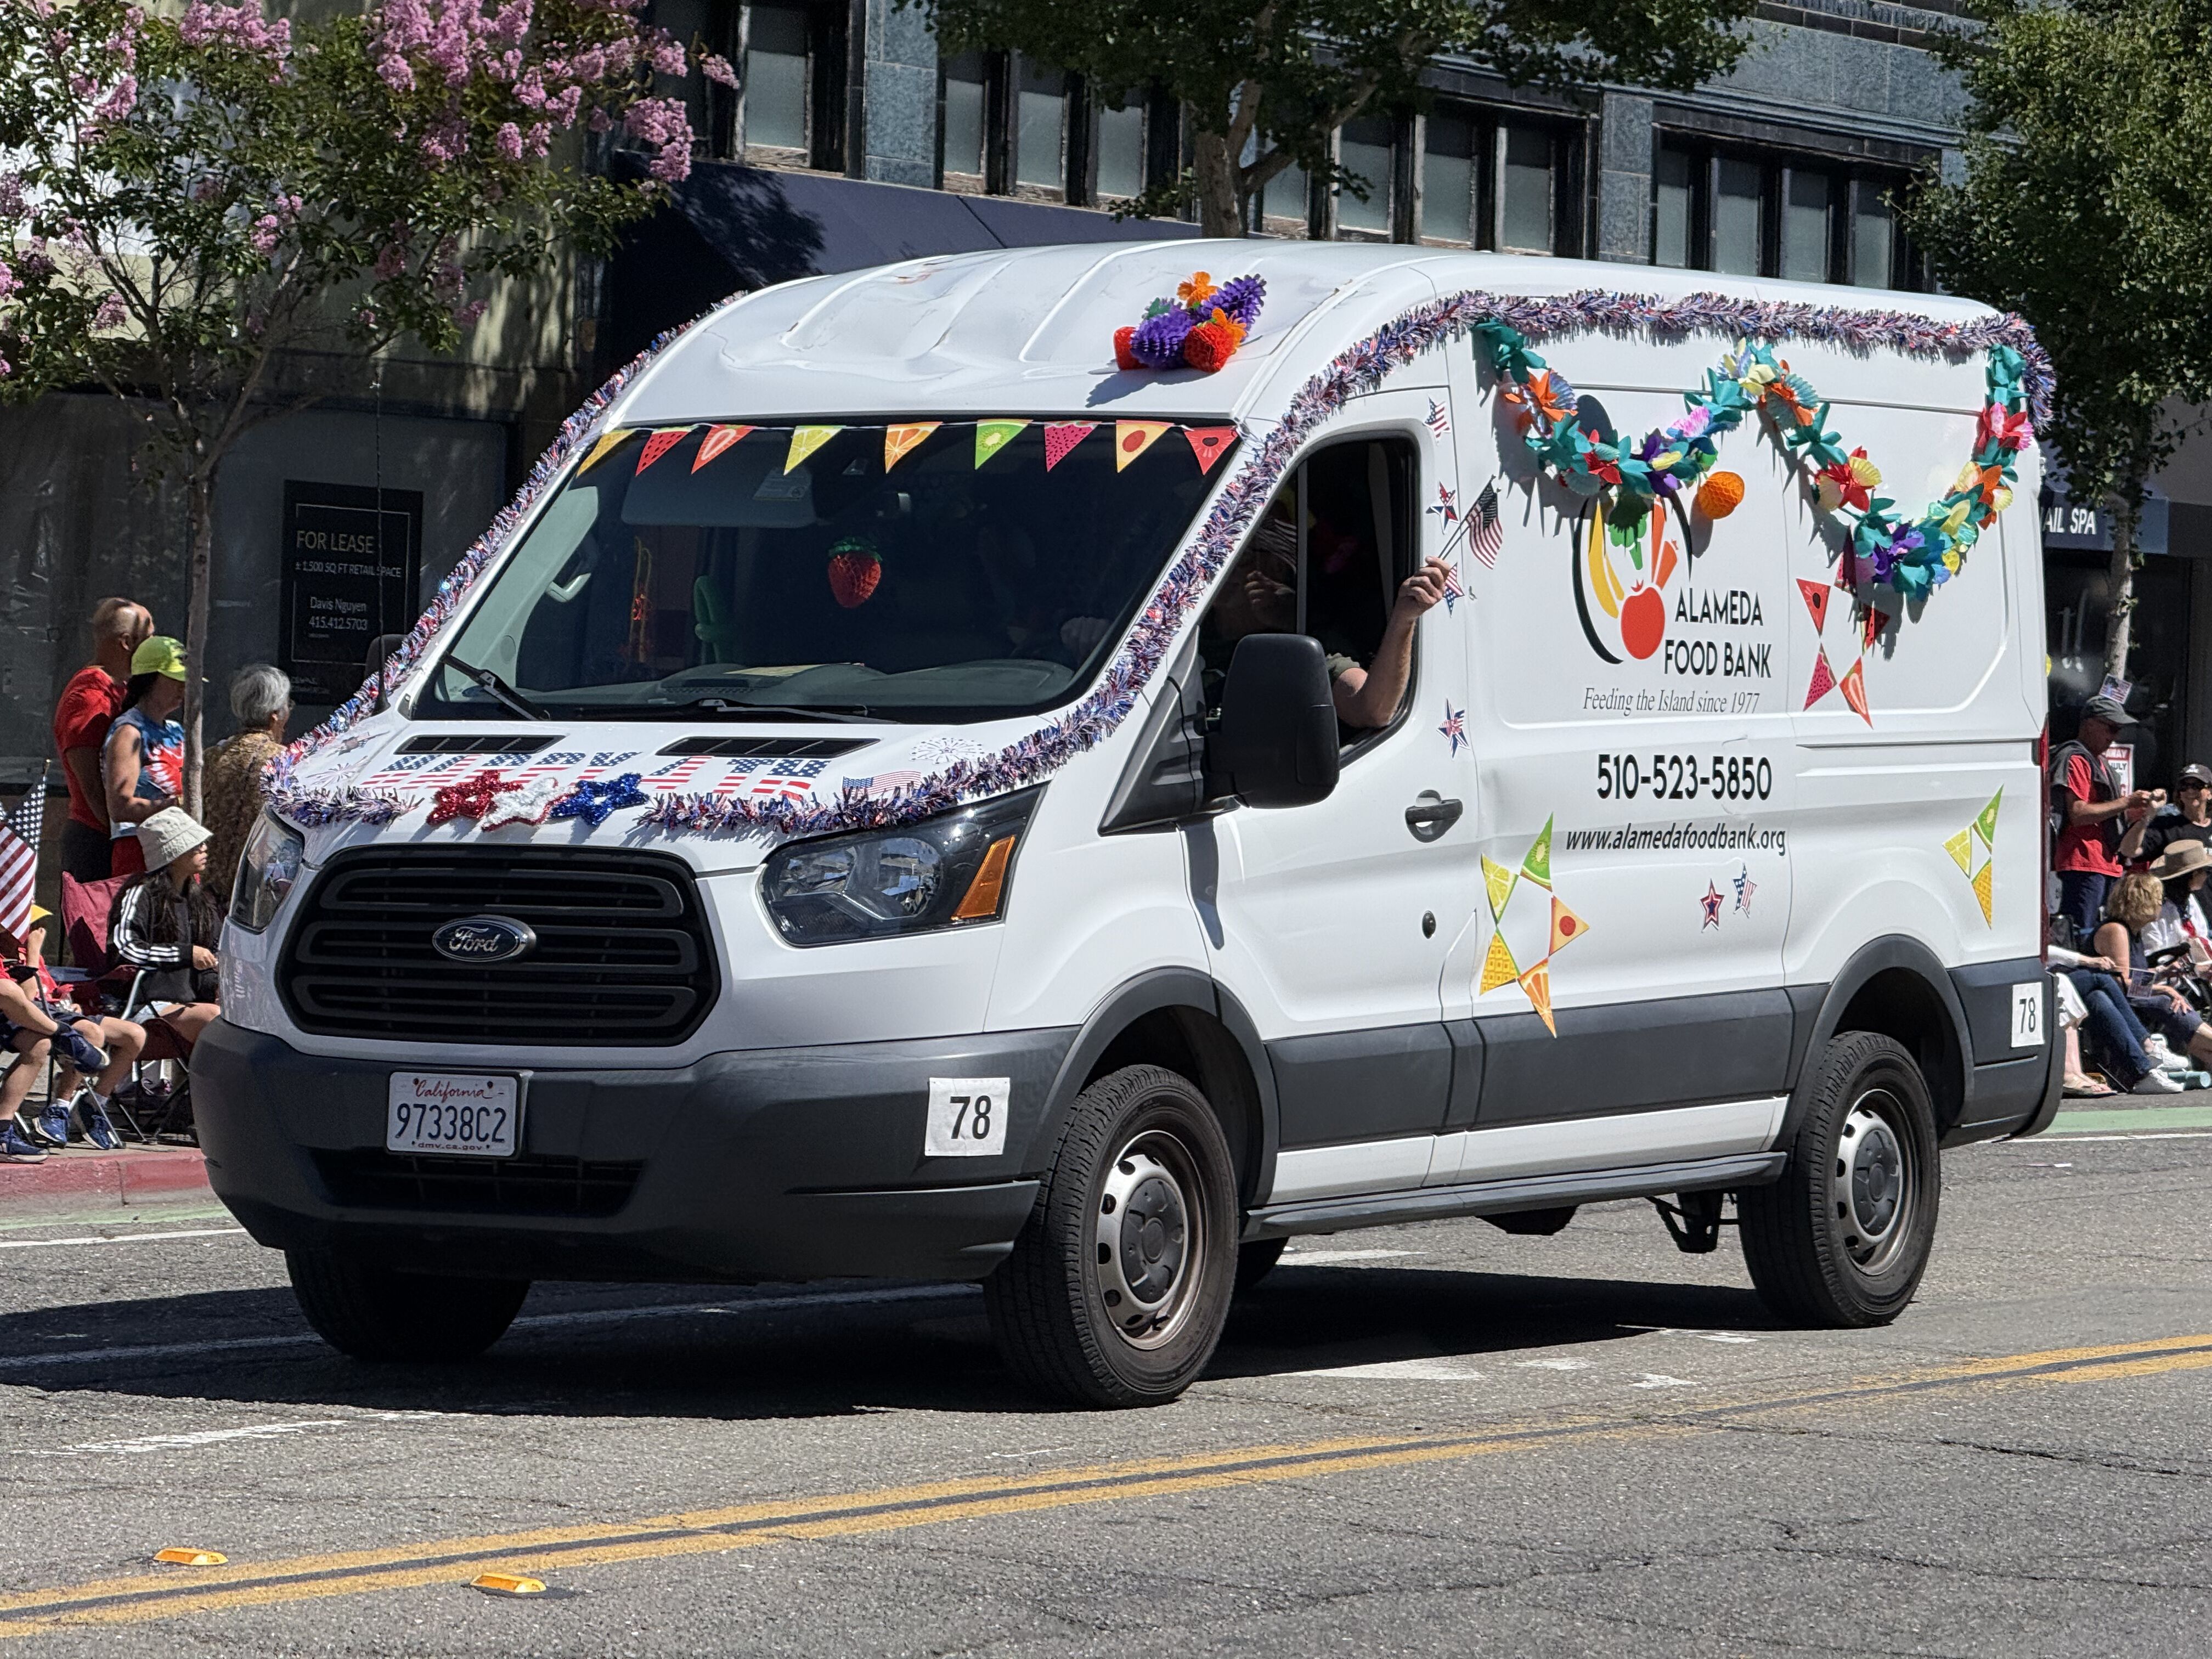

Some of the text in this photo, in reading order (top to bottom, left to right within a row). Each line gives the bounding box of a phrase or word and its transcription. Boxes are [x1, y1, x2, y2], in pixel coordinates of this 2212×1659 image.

[2040, 507, 2096, 534] AIL SPA
[296, 530, 374, 554] FOR LEASE
[349, 564, 375, 575] RETAIL
[310, 597, 366, 614] Davis Nguyen
[1675, 587, 1764, 626] ALAMEDA
[1664, 639, 1772, 678] FOOD BANK
[1583, 687, 1760, 716] Feeding the Island since 1977
[1597, 754, 1772, 800] 510-523-5850
[1566, 822, 1786, 856] www.alamedafoodbank.org
[449, 926, 500, 952] Ford
[2019, 997, 2035, 1034] 78
[415, 1080, 493, 1103] California
[395, 1103, 506, 1143] 97338C2
[950, 1095, 991, 1139] 78
[418, 1142, 482, 1150] dmv.ca.gov
